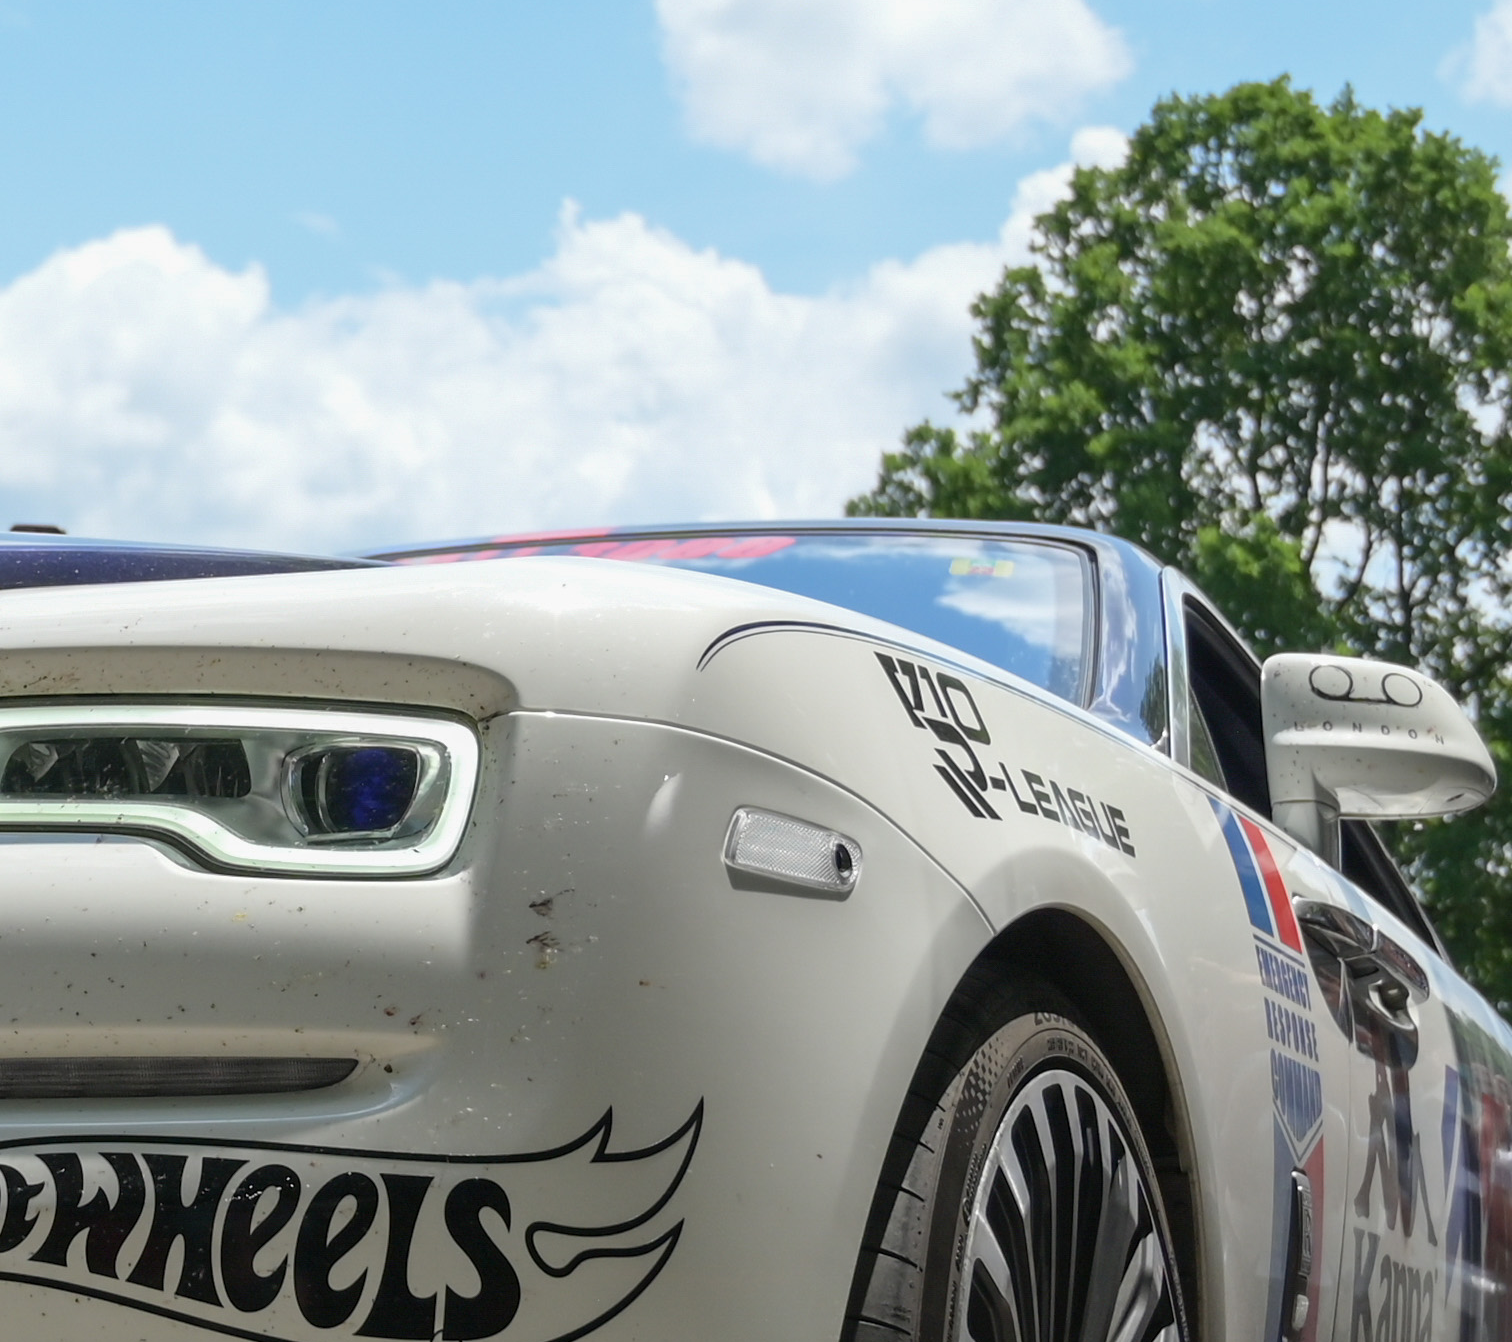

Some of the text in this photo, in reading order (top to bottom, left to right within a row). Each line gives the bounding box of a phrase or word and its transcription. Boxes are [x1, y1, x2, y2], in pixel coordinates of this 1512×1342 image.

[873, 651, 991, 745] V10
[1294, 720, 1444, 746] LONDON
[1255, 944, 1312, 1012] EMERGENCY
[1264, 996, 1319, 1062] RESPONSE
[1270, 1048, 1323, 1143] COMMAND
